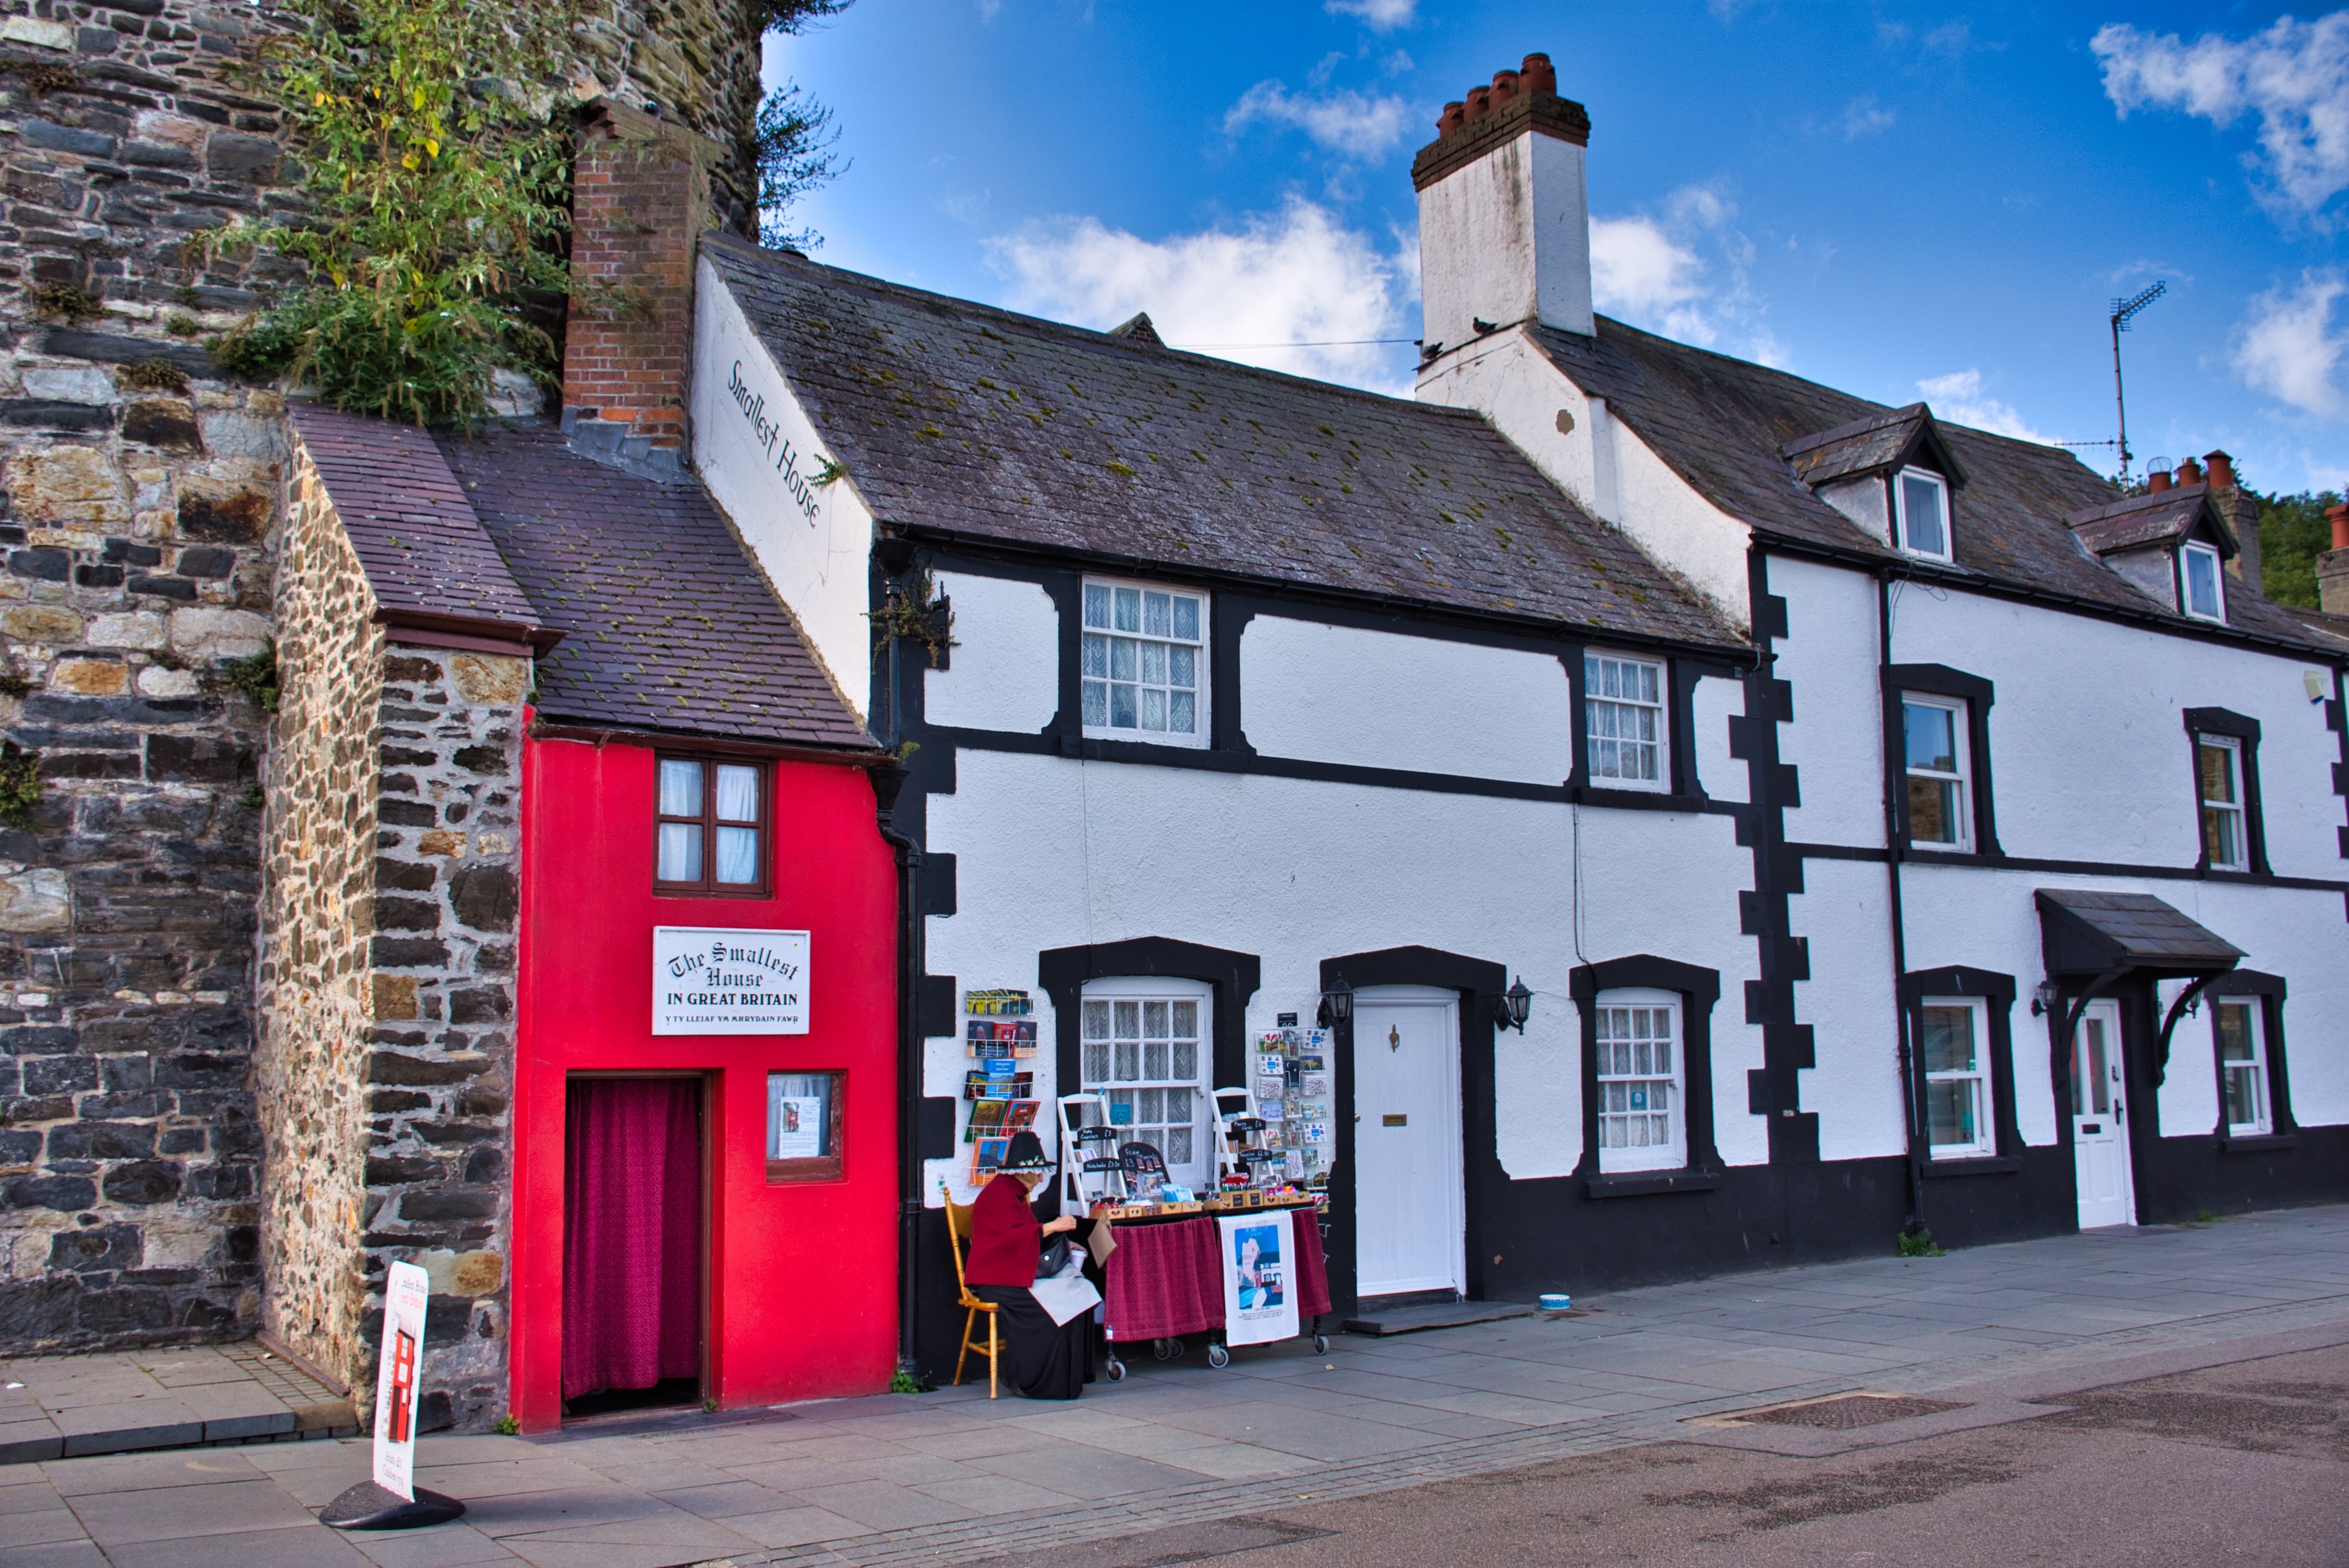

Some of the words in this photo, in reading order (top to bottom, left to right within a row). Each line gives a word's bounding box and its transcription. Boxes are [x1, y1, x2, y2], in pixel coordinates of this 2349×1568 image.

[728, 360, 780, 462] Smallest
[776, 438, 820, 529] House
[668, 953, 705, 977] The
[712, 942, 799, 980] Smallest
[706, 967, 763, 987] House
[667, 993, 682, 1005] IN
[687, 993, 737, 1005] GREAT
[741, 993, 798, 1006] BRITAIN
[1105, 1129, 1112, 1137] £3
[1125, 1158, 1135, 1167] £3
